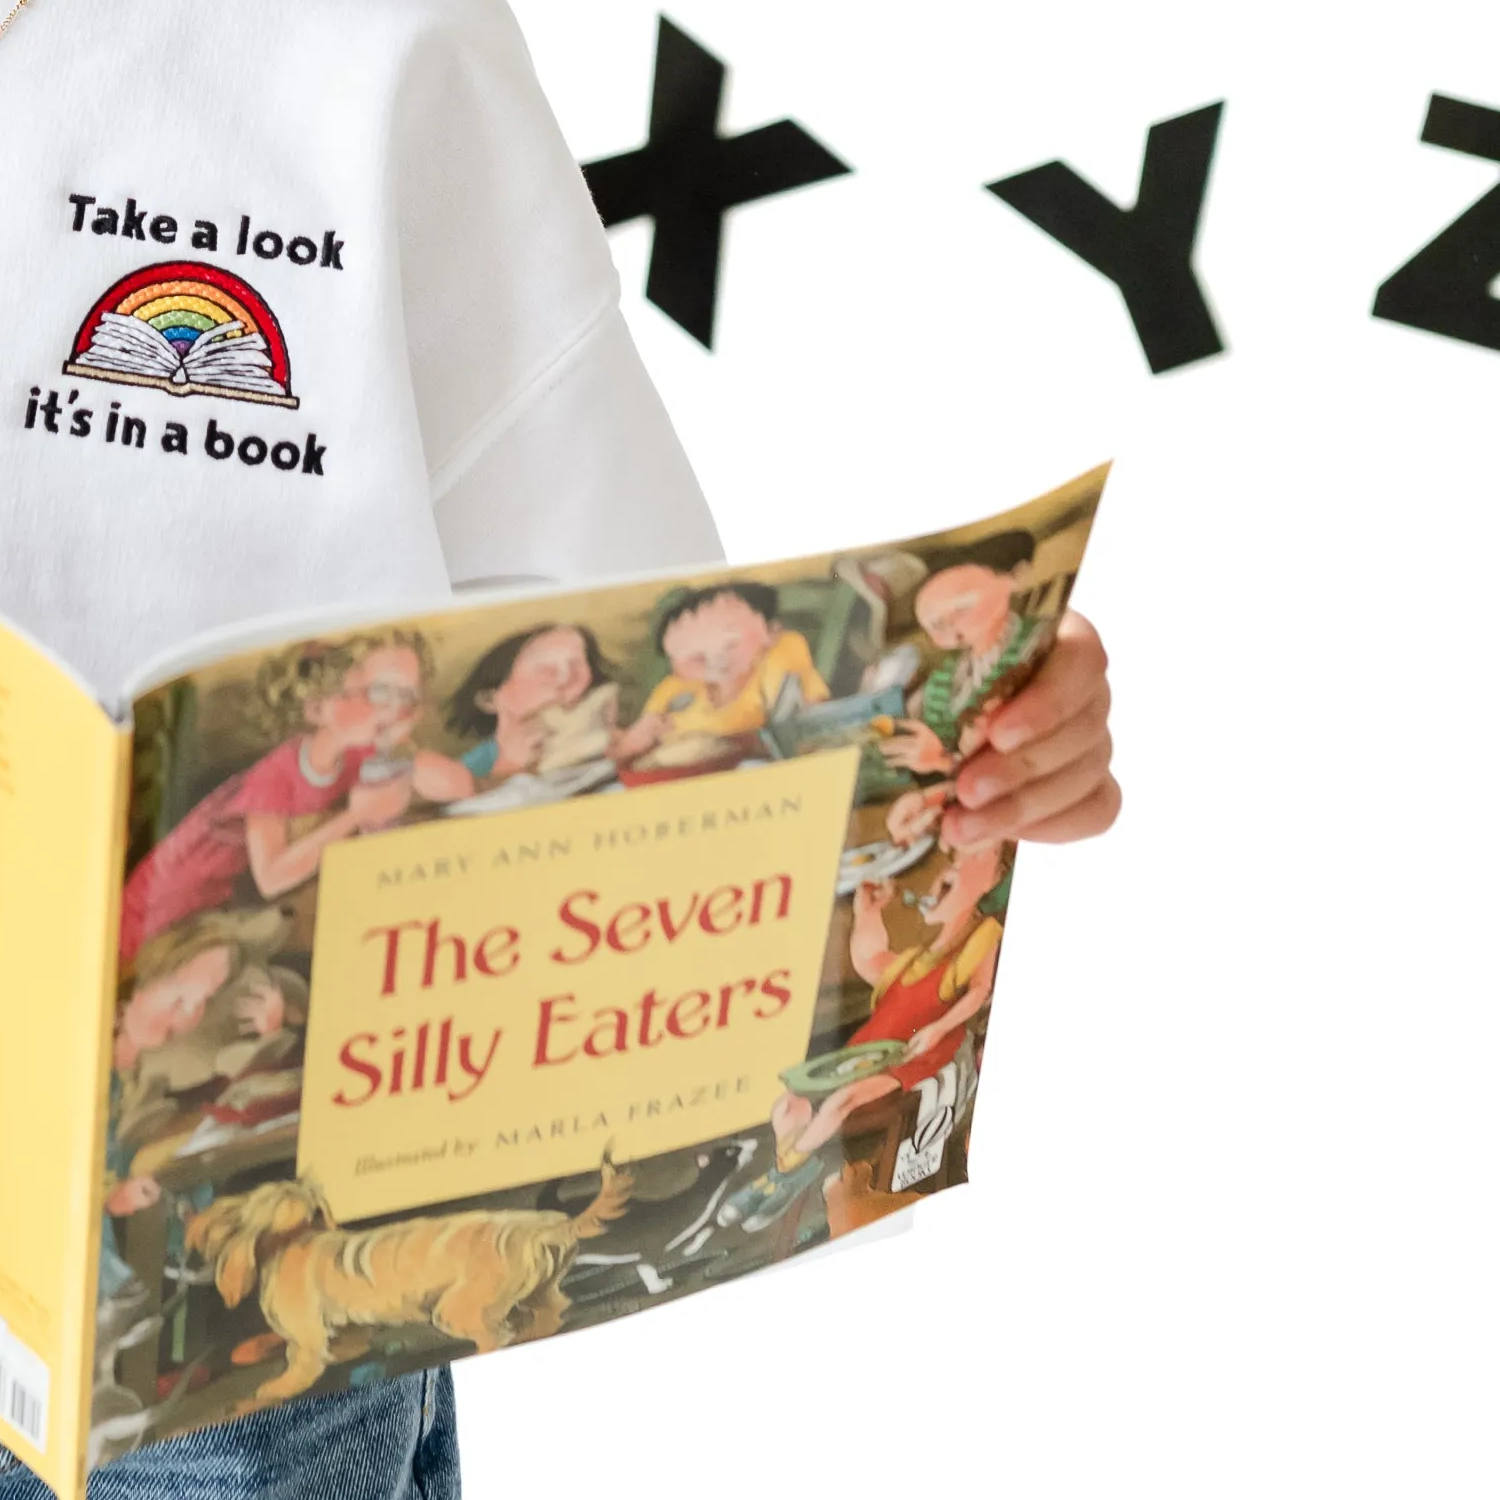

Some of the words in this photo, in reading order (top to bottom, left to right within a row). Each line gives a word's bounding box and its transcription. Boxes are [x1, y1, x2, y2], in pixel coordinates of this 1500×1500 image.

[69, 194, 178, 244] Take
[191, 220, 218, 251] a
[237, 215, 345, 270] look
[581, 15, 853, 350] X
[986, 102, 1223, 374] Y
[106, 402, 147, 449] in
[162, 422, 188, 455] a
[204, 419, 327, 476] book
[375, 853, 473, 891] MARY
[491, 836, 572, 868] ANN
[593, 794, 803, 852] HOBERMAN
[363, 916, 522, 998] The
[550, 873, 794, 967] Seven
[331, 1015, 503, 1108] Silly
[532, 967, 792, 1069] Eaters
[495, 1110, 609, 1149] MARLA
[628, 1074, 750, 1122] FRAZEE
